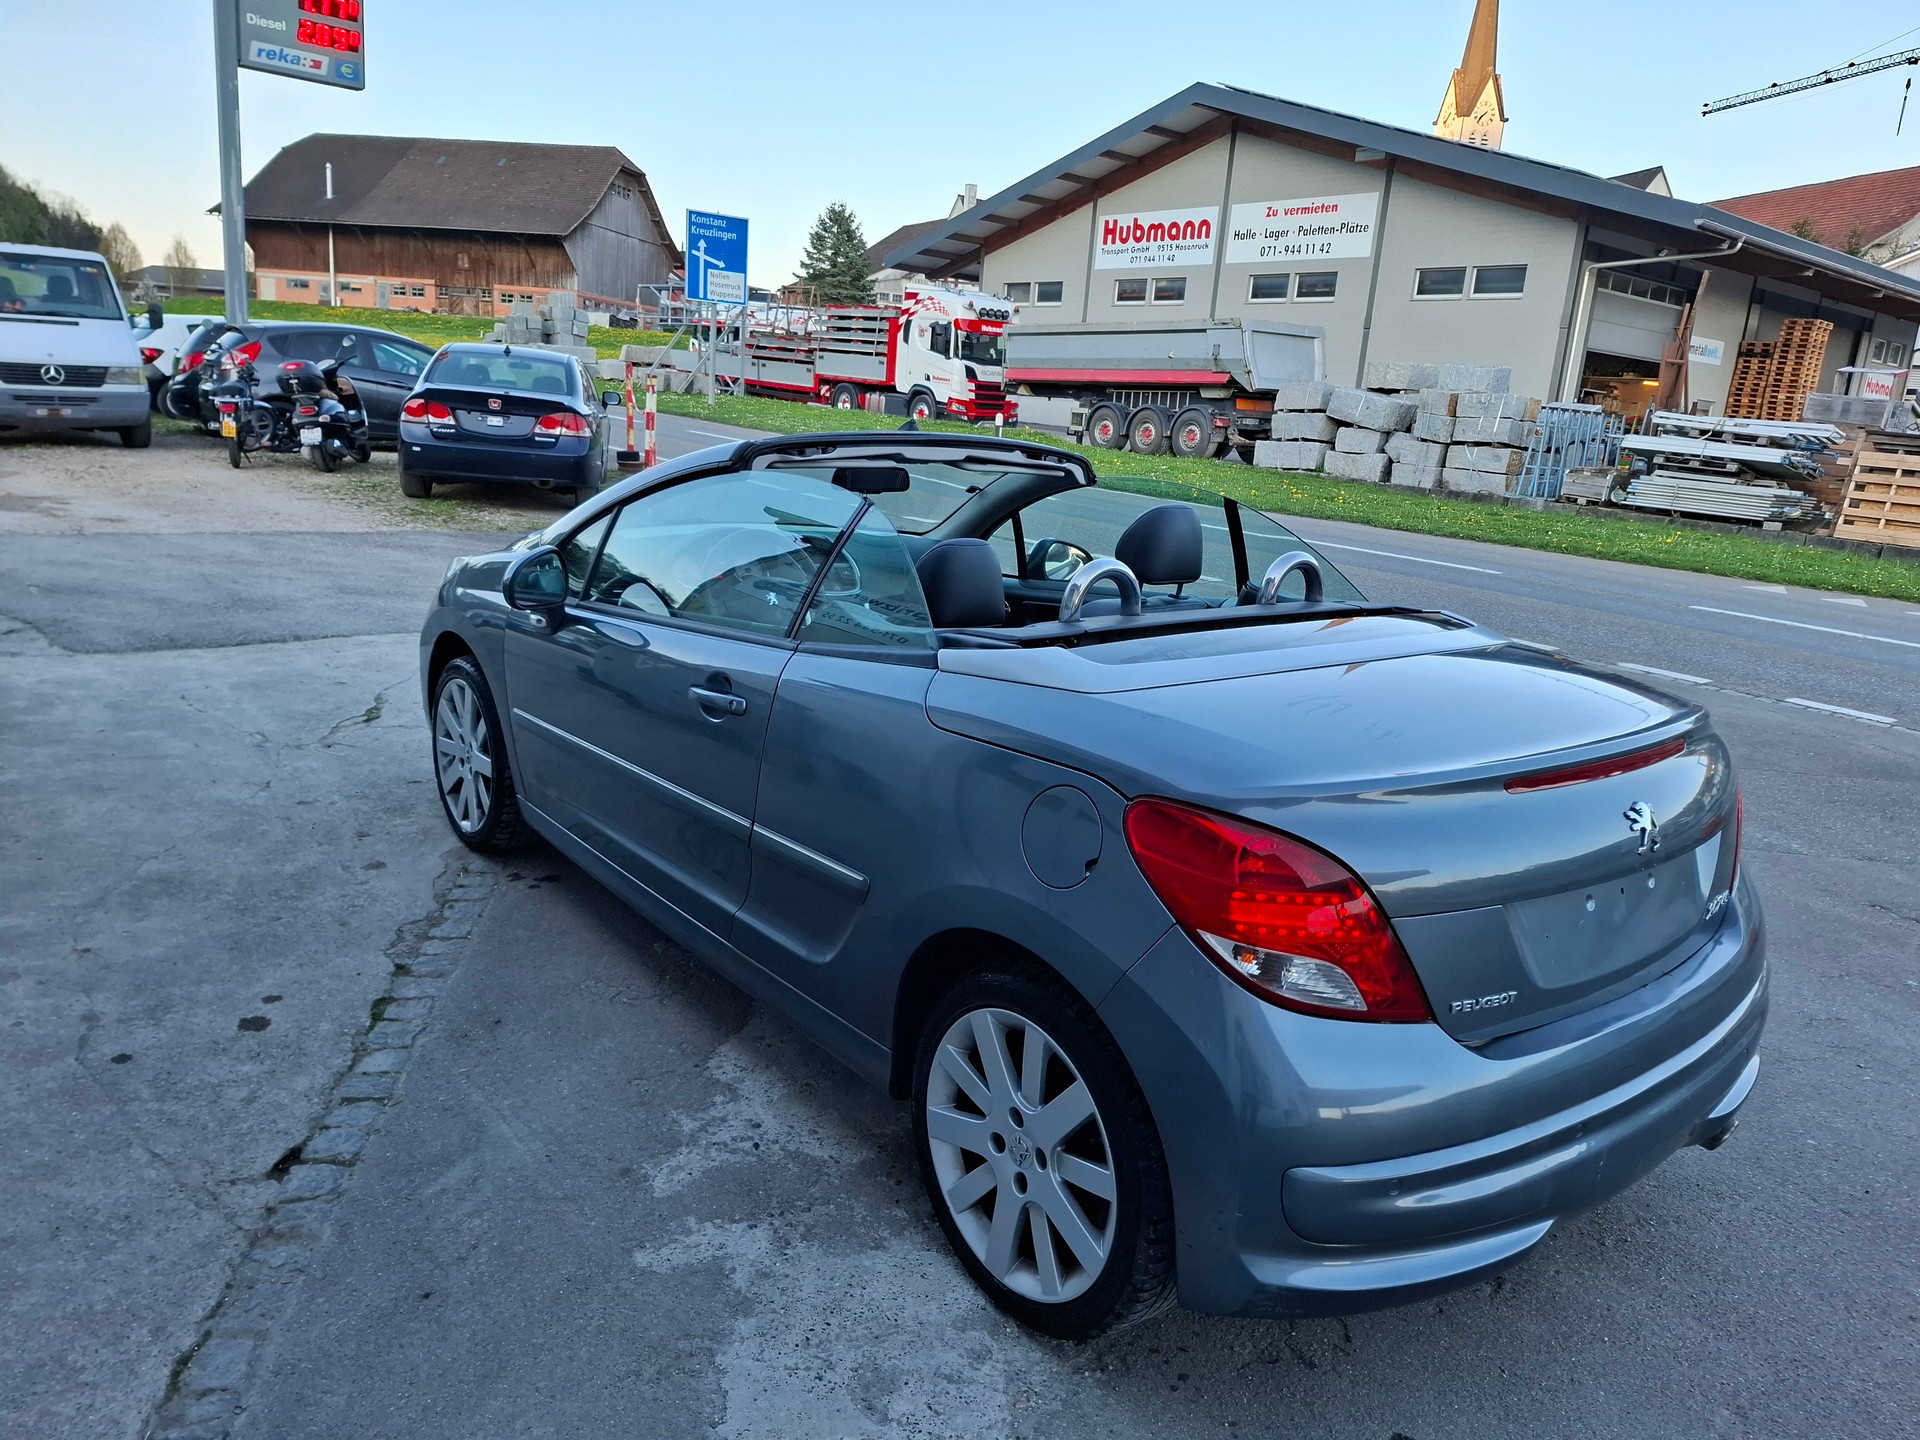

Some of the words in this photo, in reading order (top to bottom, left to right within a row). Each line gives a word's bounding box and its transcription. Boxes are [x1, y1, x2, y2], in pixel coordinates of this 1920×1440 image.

[246, 13, 287, 31] Diesel
[1265, 206, 1279, 218] Zu
[1283, 202, 1339, 216] vermieten
[691, 213, 727, 227] Konstanz
[691, 225, 737, 241] Kreuzlingen
[1102, 217, 1211, 245] Hubmann
[1233, 228, 1257, 241] Halle
[1264, 228, 1290, 241] Lager
[1297, 221, 1370, 237] Paletten-Plätze
[1101, 247, 1129, 256] Transport
[1130, 245, 1150, 254] GmbH
[1157, 243, 1174, 252] 9515
[1175, 242, 1209, 251] Hosenruck
[1305, 243, 1316, 255] 11
[1318, 242, 1332, 254] 42
[1130, 256, 1142, 264] 071
[1143, 255, 1156, 263] 944
[1157, 255, 1166, 263] 11
[1166, 254, 1176, 262] 42
[710, 271, 730, 280] Nollen
[710, 281, 741, 291] Hosenruck
[709, 289, 742, 300] Wuppenau
[1450, 990, 1518, 1015] PEUGEOT
